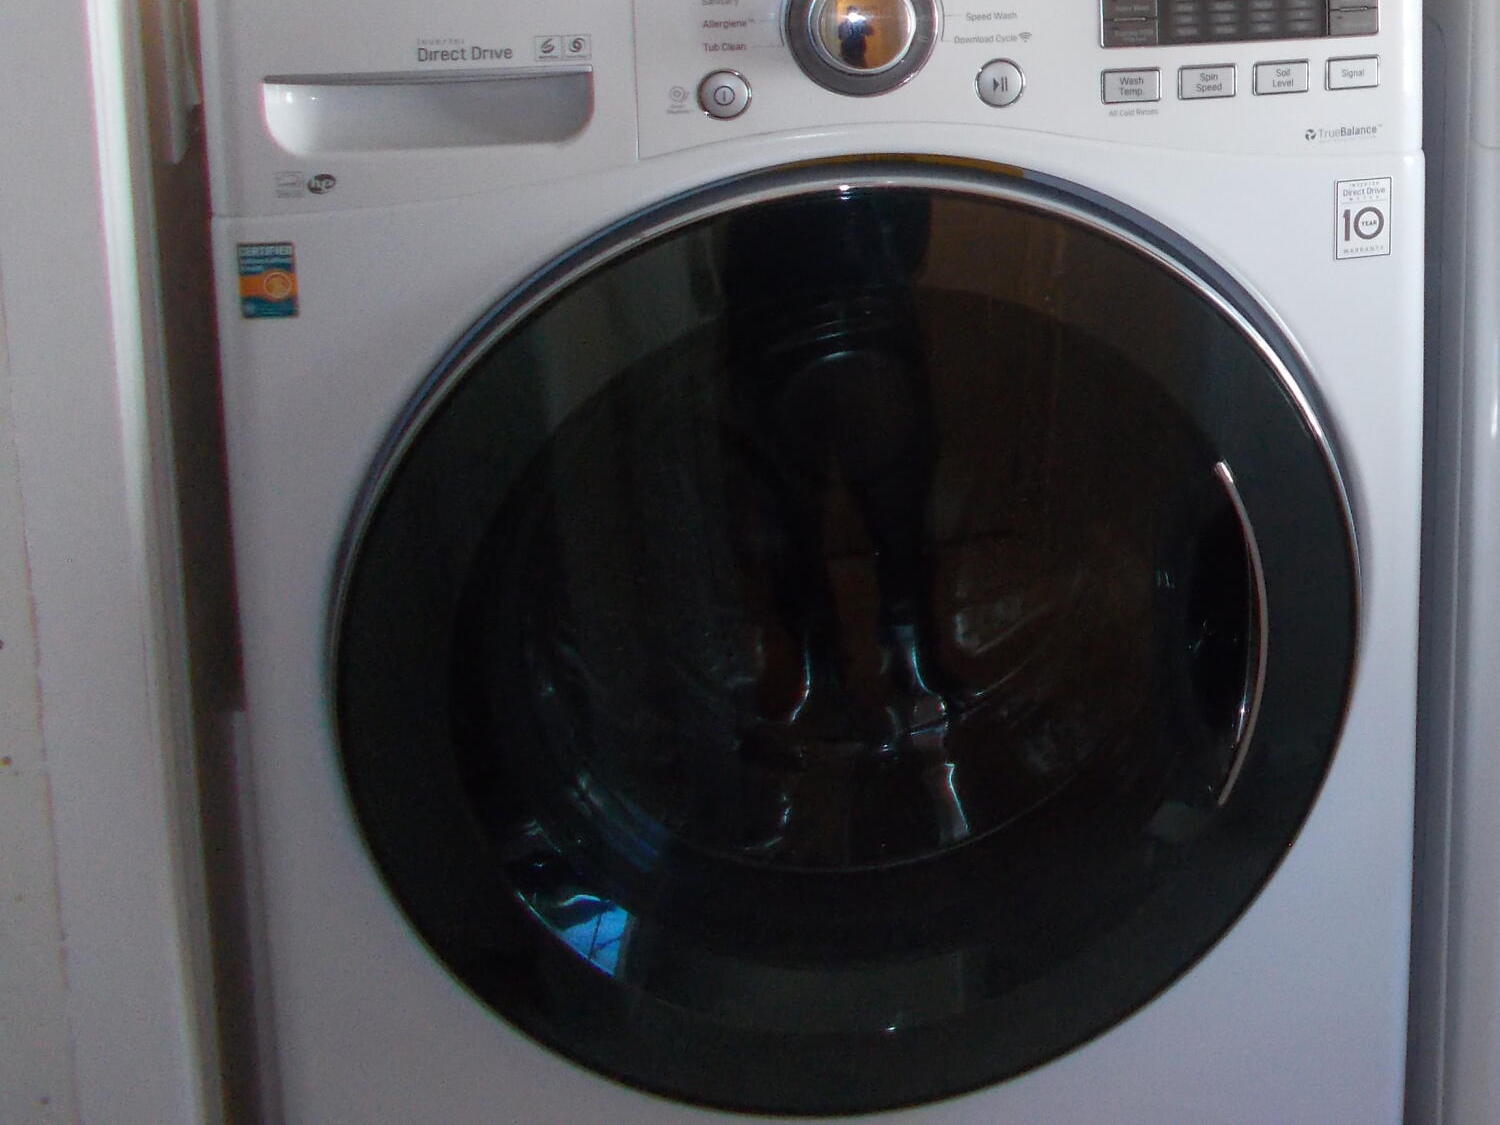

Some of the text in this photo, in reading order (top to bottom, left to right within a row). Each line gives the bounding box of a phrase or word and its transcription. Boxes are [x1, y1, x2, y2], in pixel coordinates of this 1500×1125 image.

[966, 11, 1018, 22] Speed Wash
[954, 34, 1018, 44] Download Cycle
[703, 42, 747, 52] Tub Clean
[418, 46, 513, 62] Direct Drive
[1200, 72, 1218, 83] Spin
[1276, 68, 1291, 77] Soil
[1342, 68, 1365, 79] Signal
[1119, 76, 1144, 85] Wash
[1272, 78, 1294, 88] Level
[1196, 82, 1222, 93] Speed
[1343, 186, 1386, 197] Direct Drive
[1343, 206, 1385, 242] 10
